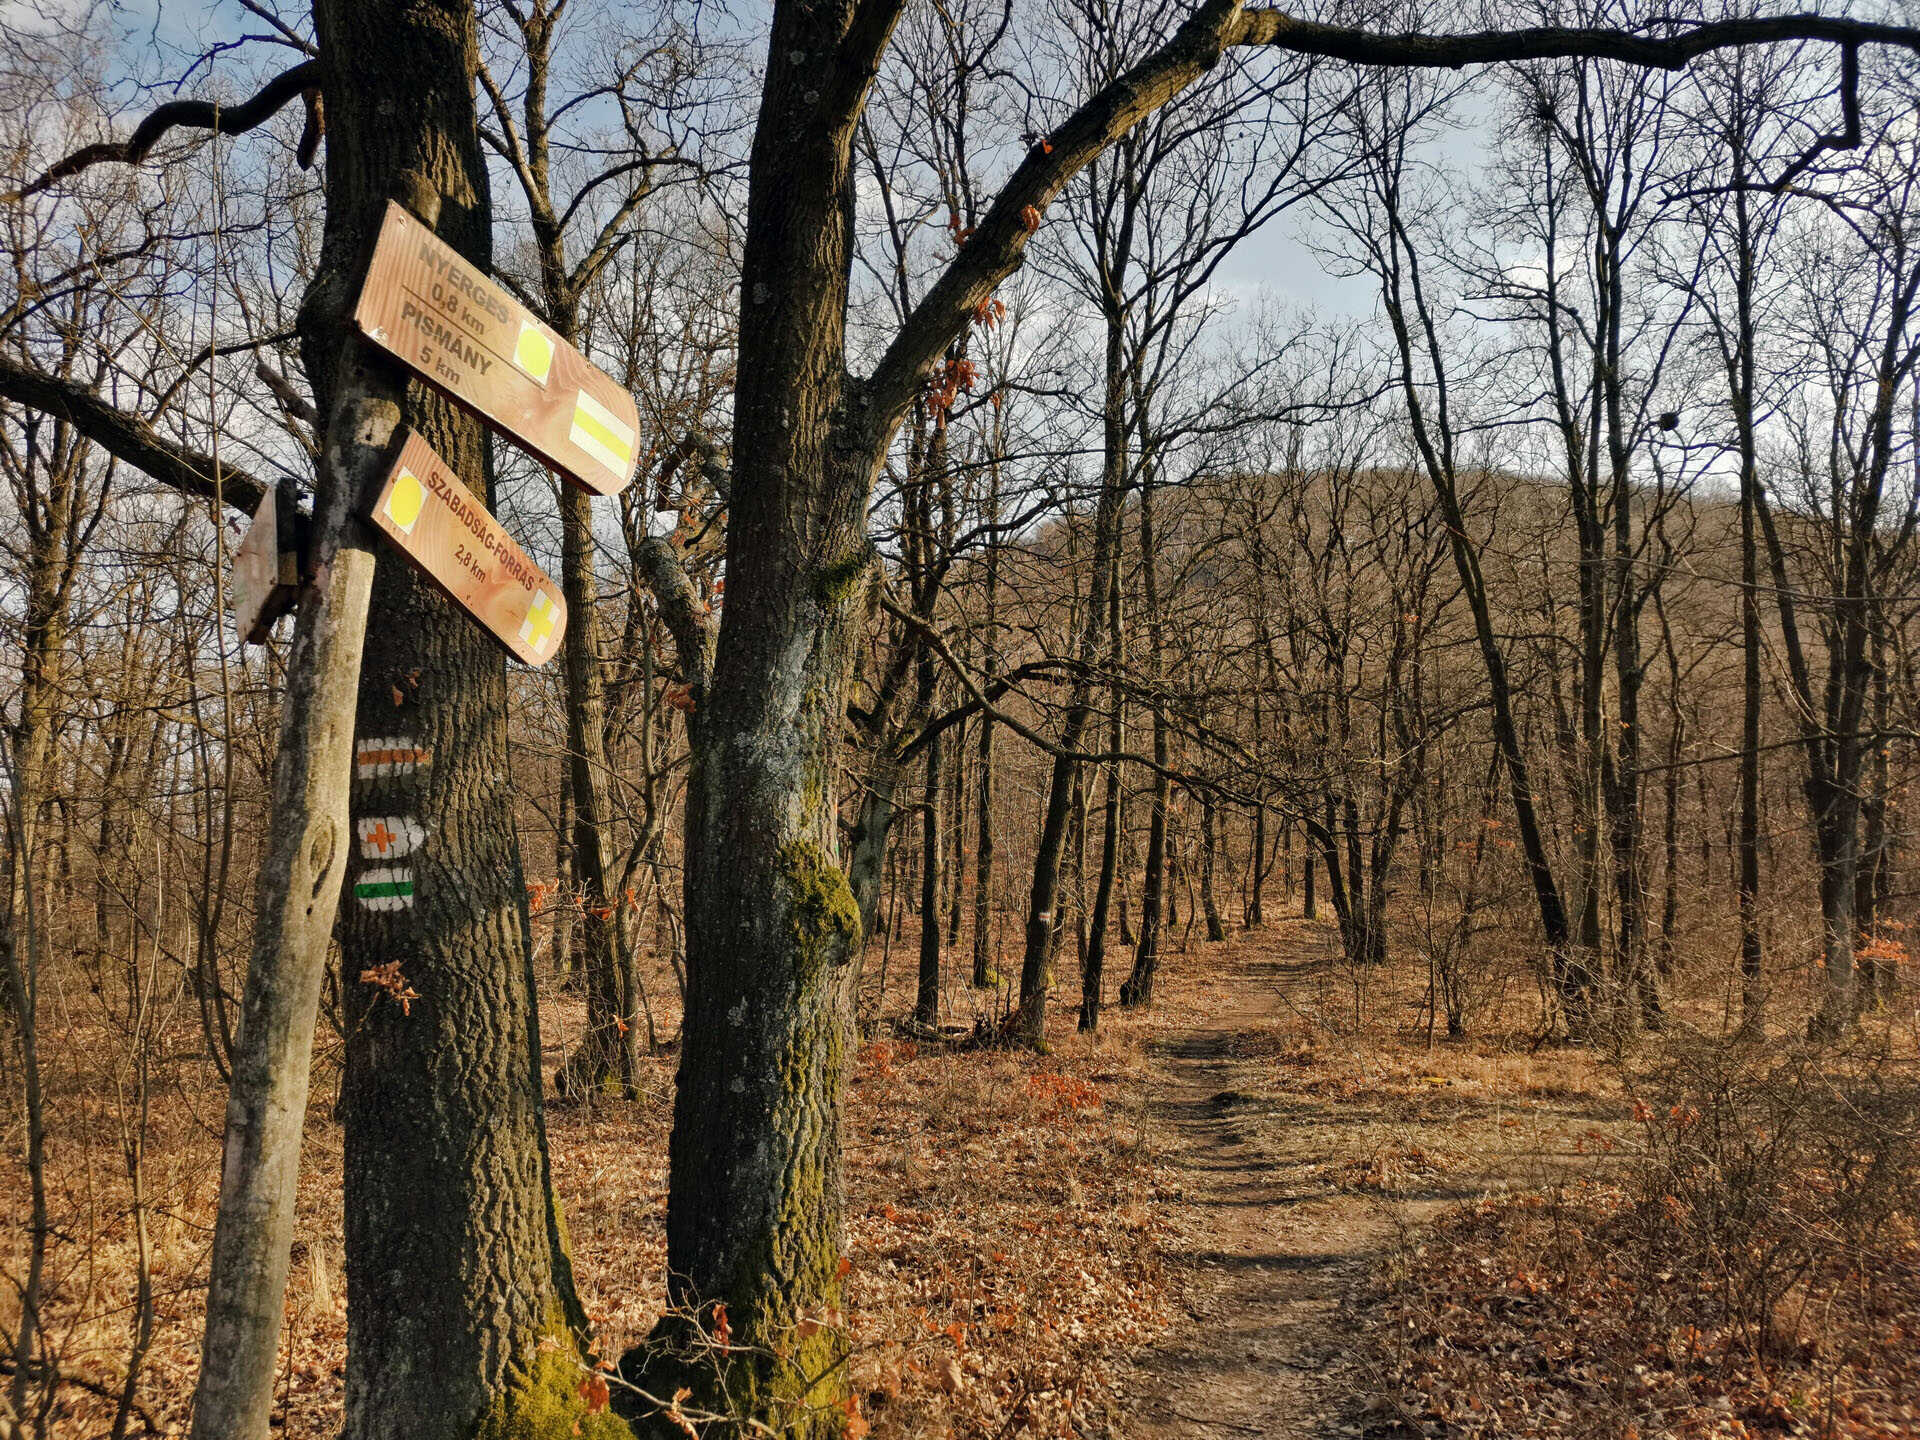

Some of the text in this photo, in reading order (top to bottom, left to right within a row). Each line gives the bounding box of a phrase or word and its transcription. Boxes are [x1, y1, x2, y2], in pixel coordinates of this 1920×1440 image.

[418, 243, 510, 324] NYERGES
[431, 282, 485, 335] 0,8 km
[401, 301, 493, 377] PISMÁNY
[420, 346, 461, 385] 5 km
[427, 471, 535, 592] SZABADSÁG-FORRÁS
[454, 544, 487, 583] 2,8 km
